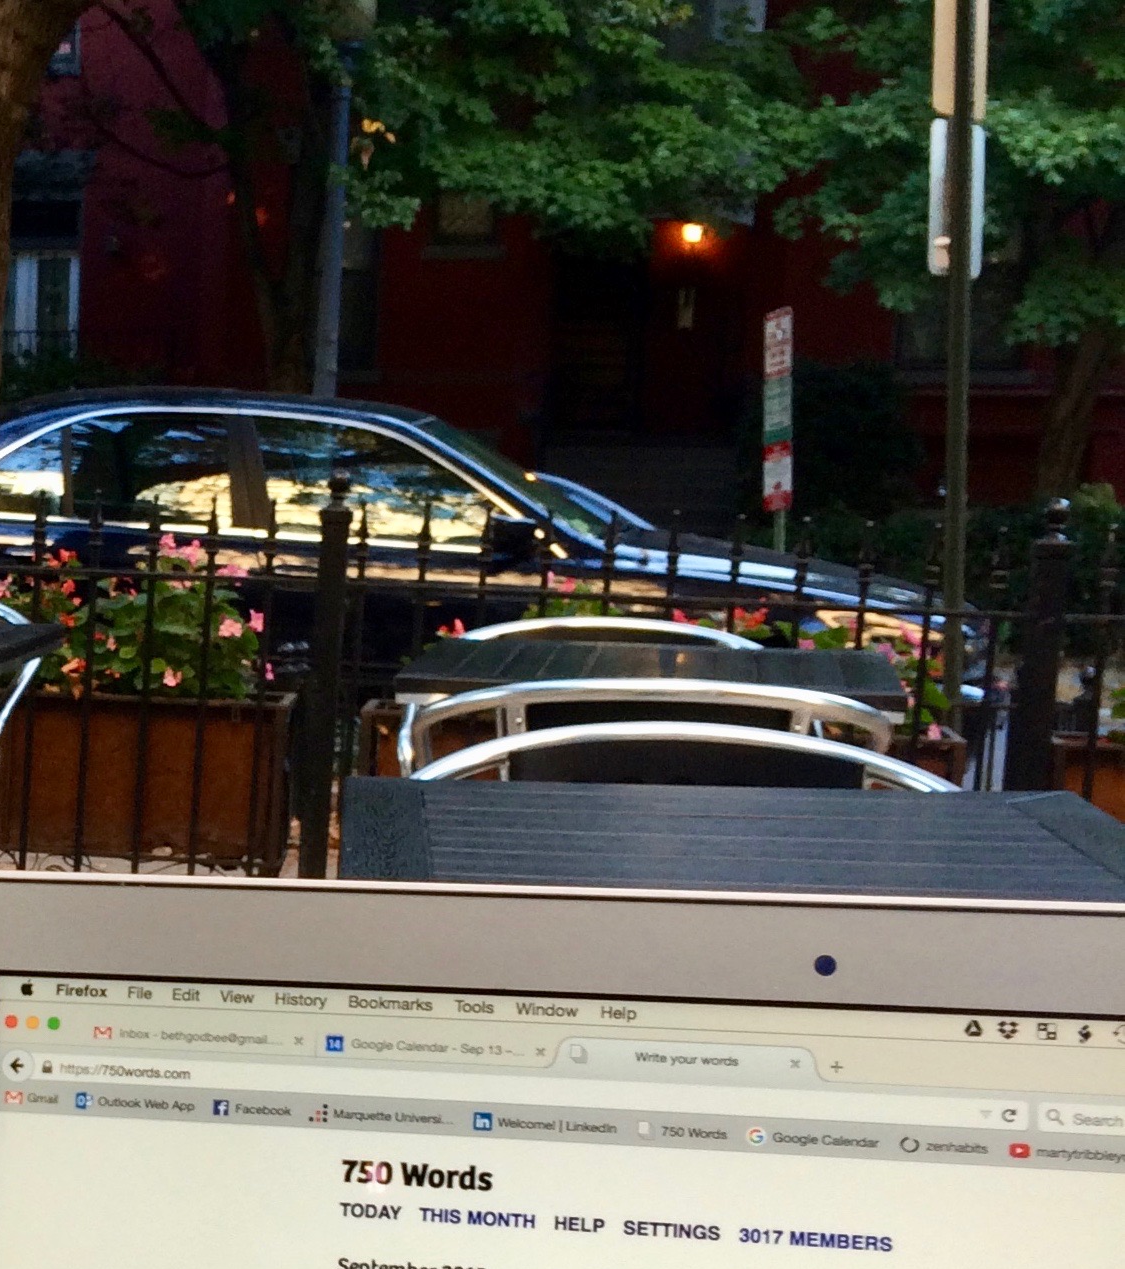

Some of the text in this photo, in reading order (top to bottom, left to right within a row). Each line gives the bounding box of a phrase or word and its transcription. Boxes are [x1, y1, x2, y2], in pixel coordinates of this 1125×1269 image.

[56, 983, 637, 1023] Firefox File Edit View History Bookmarks Tools Window Help
[235, 1103, 291, 1116] Facebook
[772, 1131, 880, 1148] Google Calendar
[342, 1159, 493, 1192] 750 Words
[340, 1202, 402, 1220] TODAY
[419, 1207, 535, 1229] THIS MONTH
[555, 1215, 605, 1233] HELP
[624, 1220, 720, 1241] SETTINGS
[739, 1227, 893, 1253] 3017 MEMBERS
